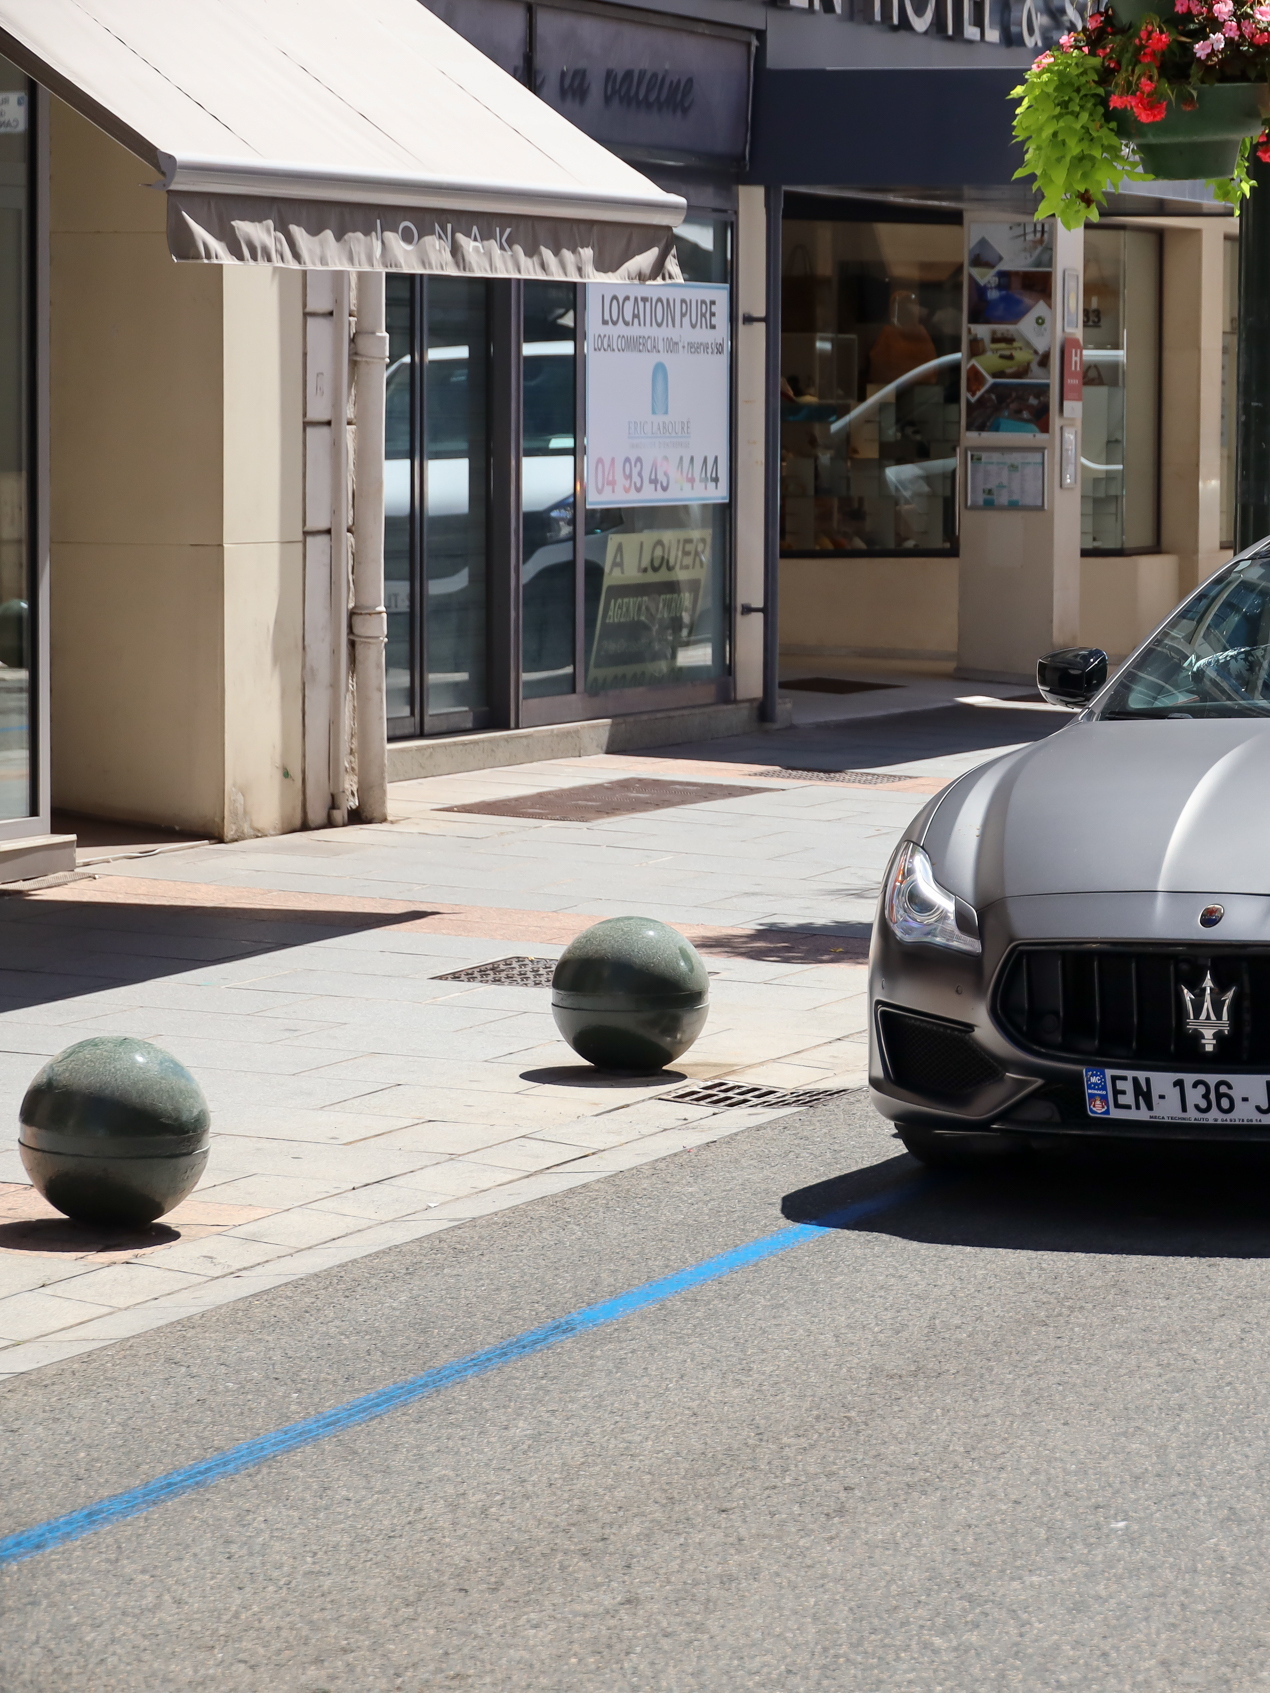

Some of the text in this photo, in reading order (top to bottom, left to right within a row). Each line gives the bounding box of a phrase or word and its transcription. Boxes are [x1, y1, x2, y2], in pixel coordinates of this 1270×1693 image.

[376, 219, 513, 259] JONAK
[601, 294, 717, 329] LOCATION PURE
[593, 333, 615, 352] LOCAL
[616, 335, 660, 354] COMMERCIAL
[687, 340, 710, 355] reserve
[1071, 348, 1081, 371] H
[627, 418, 692, 436] ERIC LABOURÉ
[594, 455, 720, 495] 04 93 43 44 44
[608, 537, 708, 576] A LOUER
[605, 596, 649, 623] AGENCE
